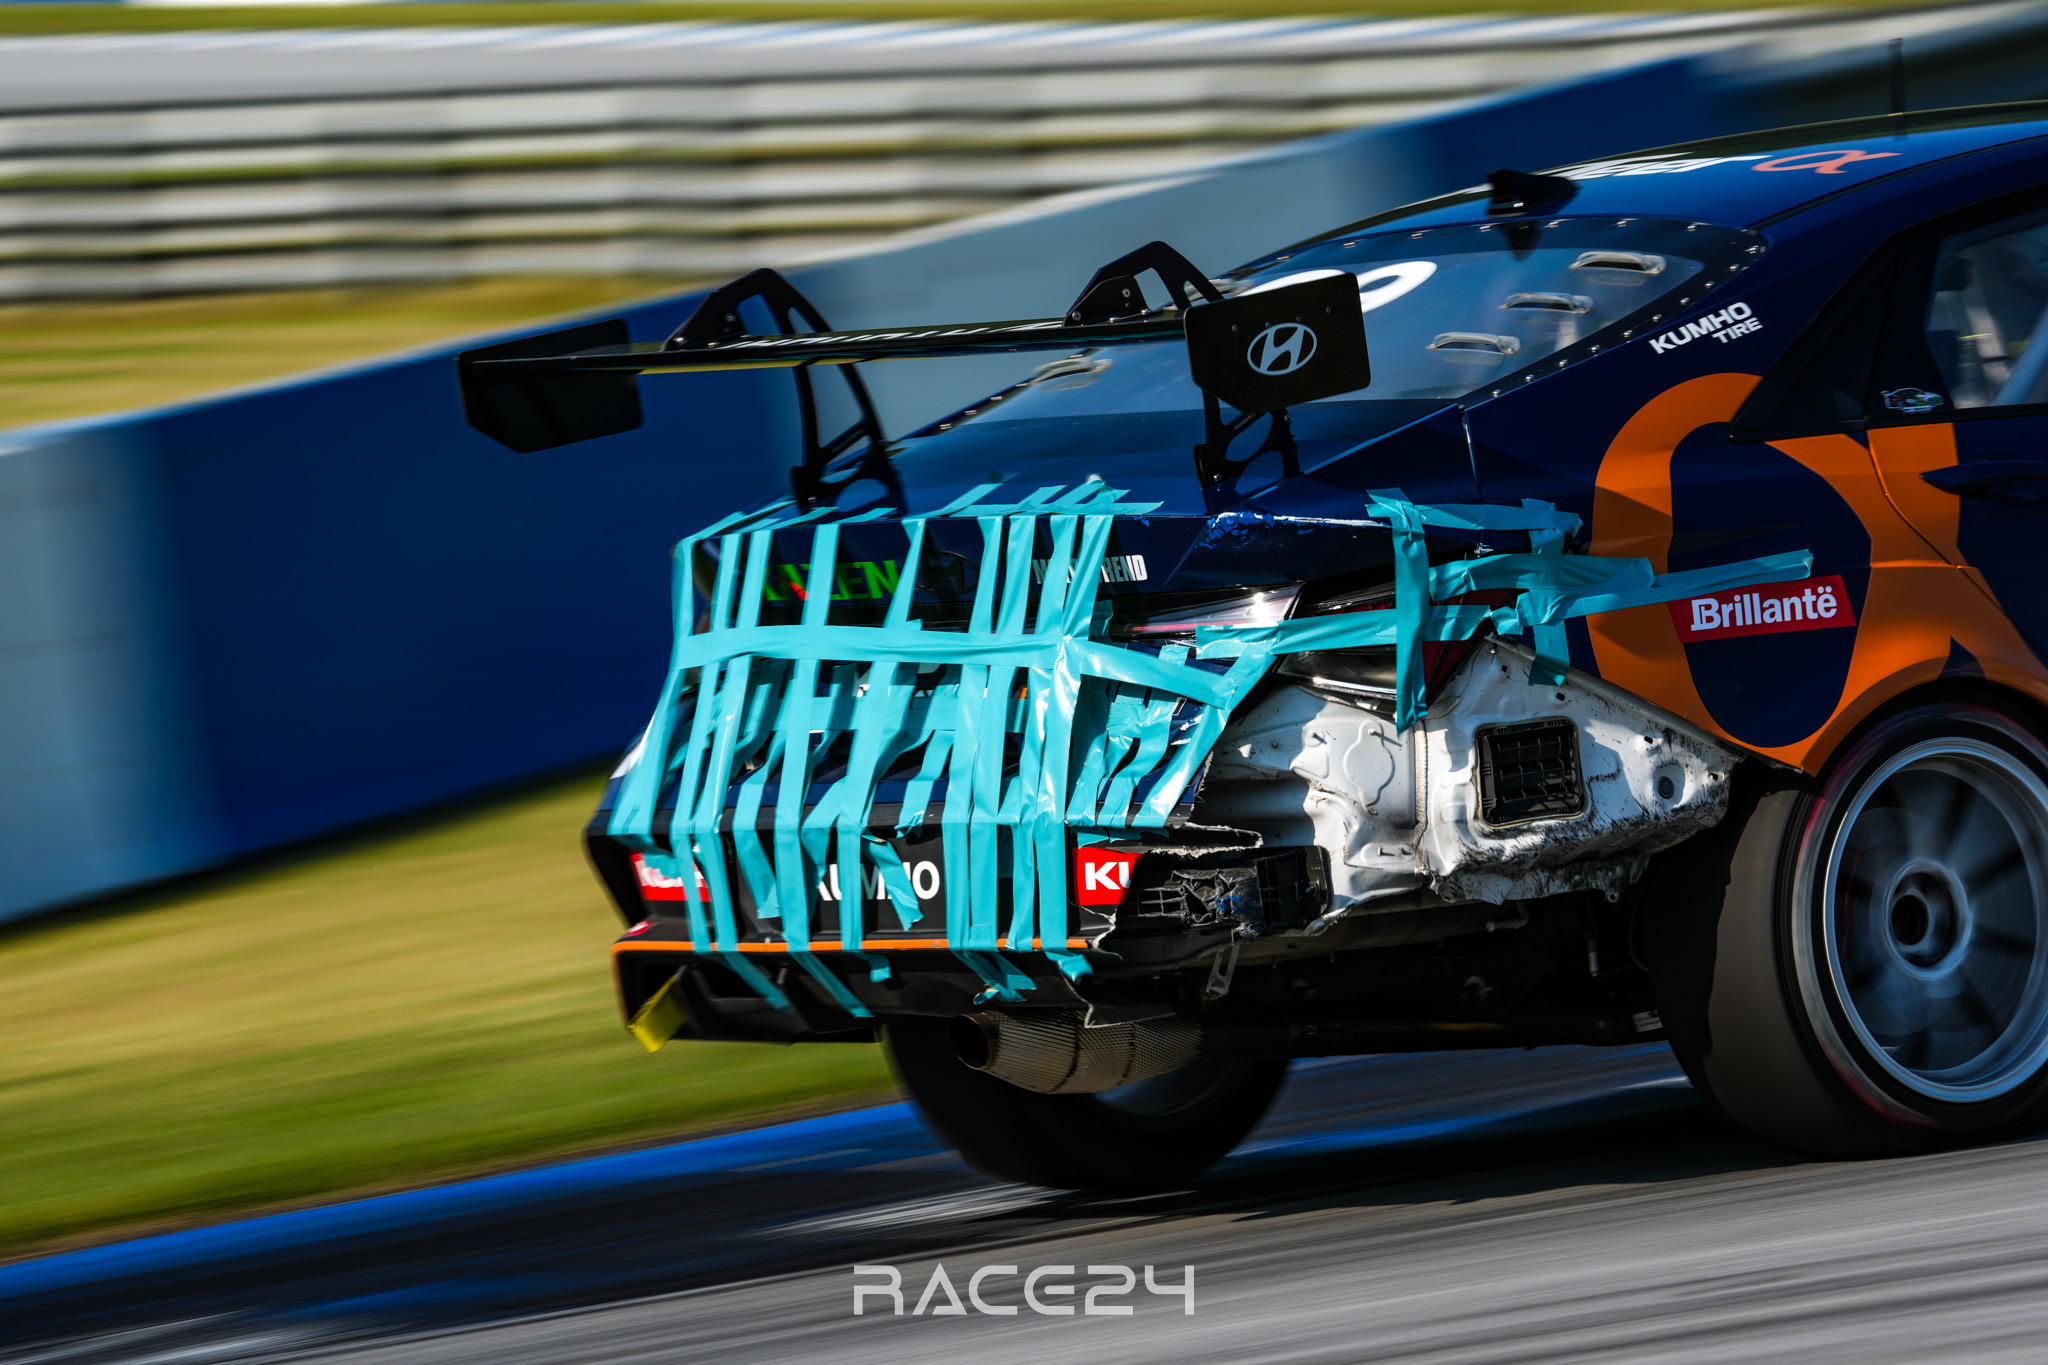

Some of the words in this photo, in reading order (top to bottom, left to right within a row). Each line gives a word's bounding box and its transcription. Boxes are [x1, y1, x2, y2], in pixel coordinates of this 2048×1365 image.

[1648, 301, 1752, 354] KUMHO
[1711, 317, 1764, 344] TIRE
[1691, 585, 1837, 631] Brillantë
